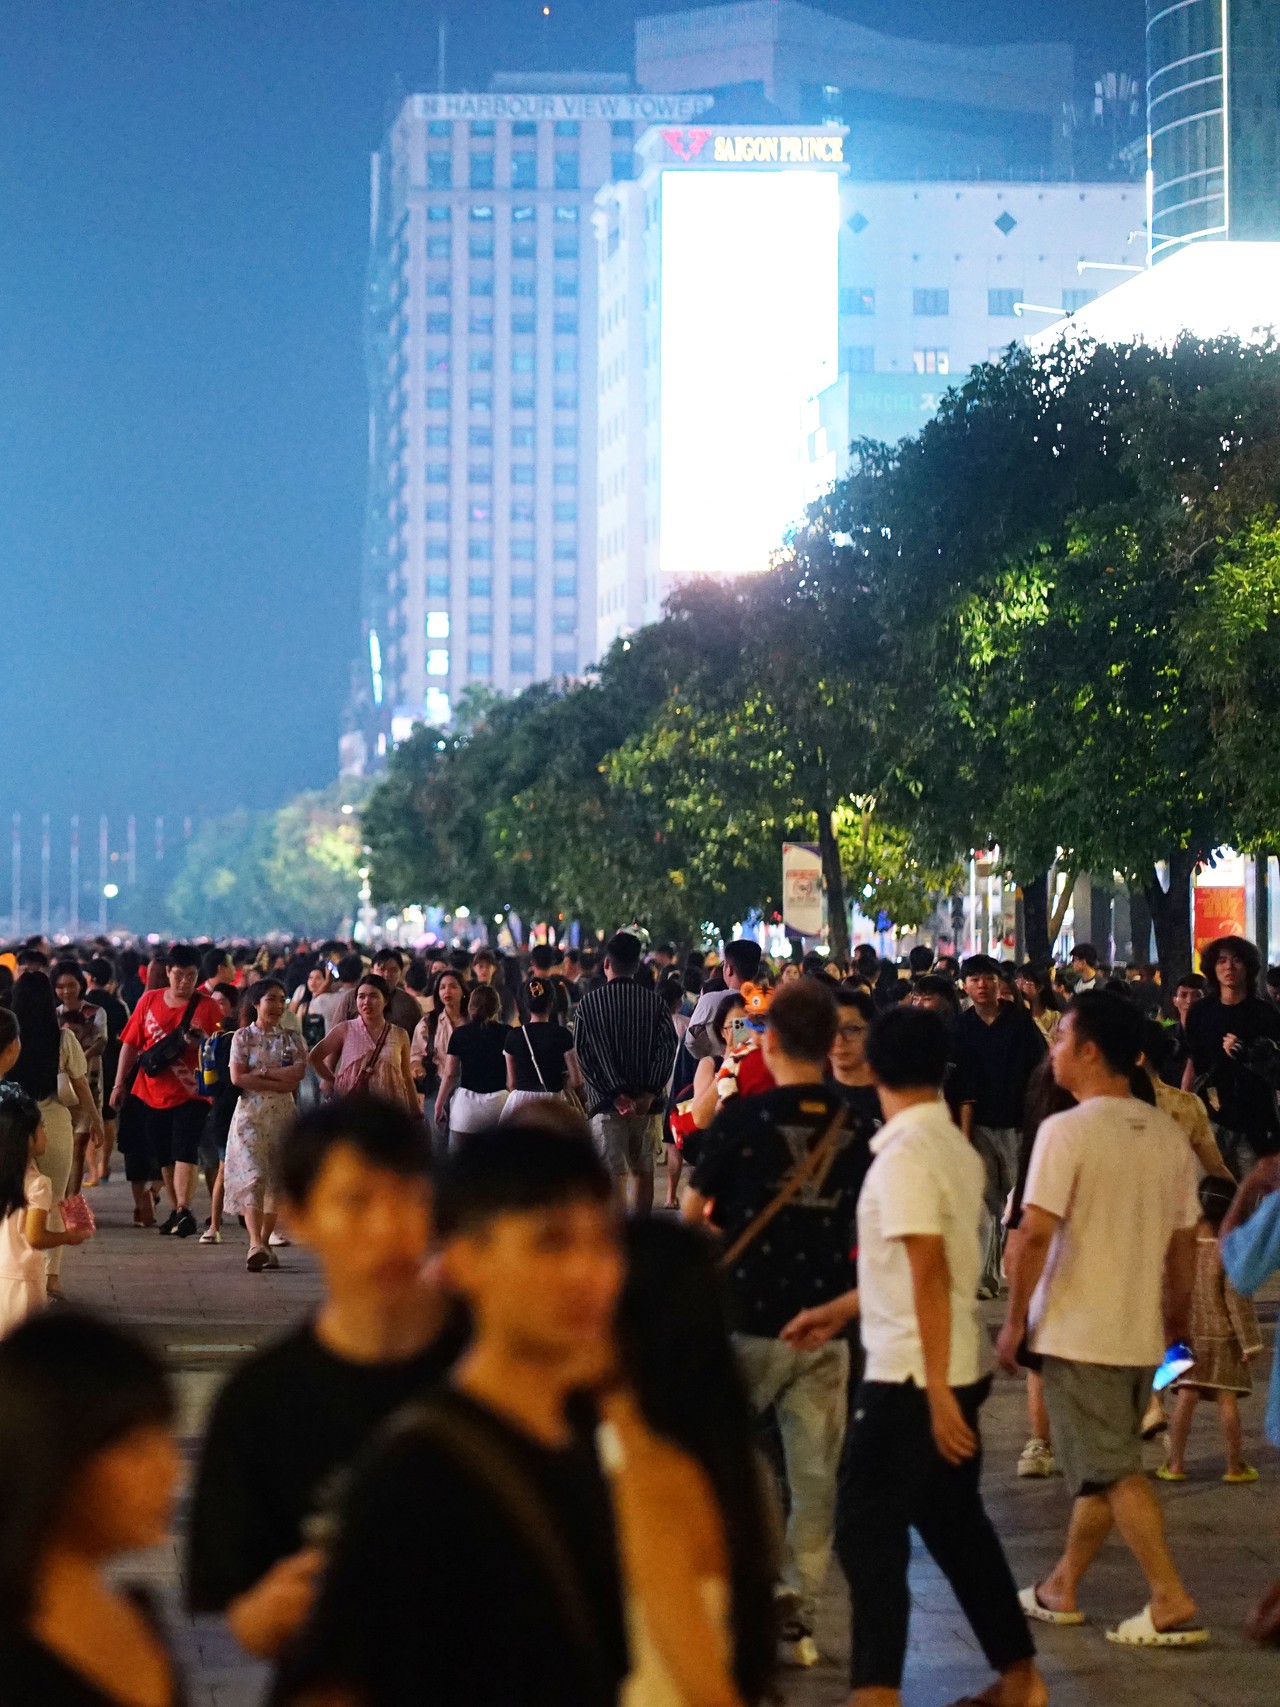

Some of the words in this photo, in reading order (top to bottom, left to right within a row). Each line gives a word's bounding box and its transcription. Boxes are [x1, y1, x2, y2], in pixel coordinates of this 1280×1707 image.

[445, 95, 556, 116] HARBOUR
[562, 95, 620, 117] VIEW
[714, 136, 778, 162] SAIGON
[779, 136, 844, 162] PRINCE
